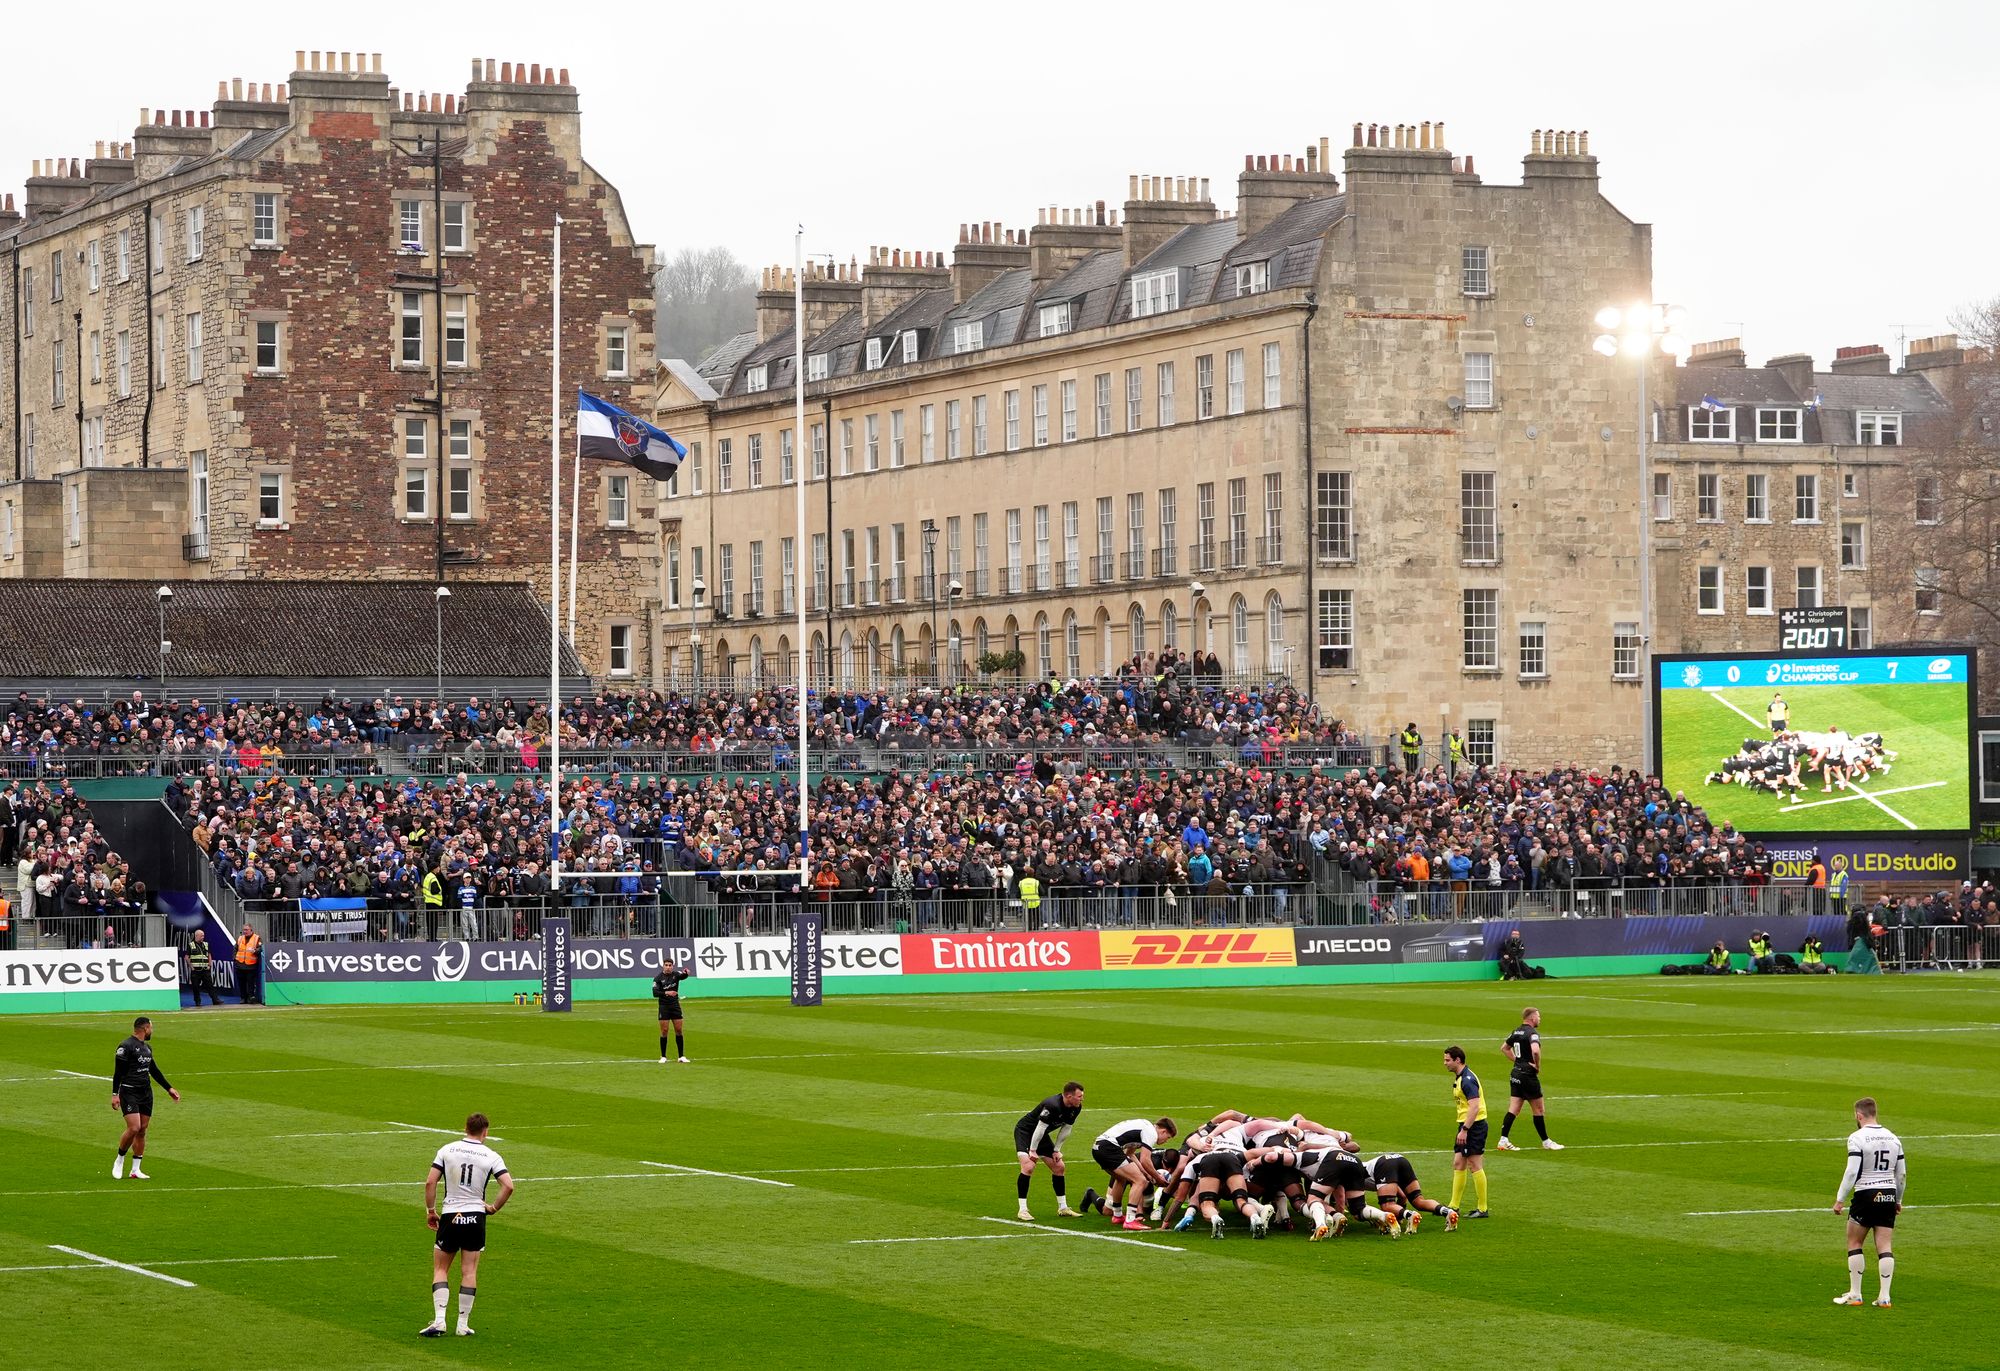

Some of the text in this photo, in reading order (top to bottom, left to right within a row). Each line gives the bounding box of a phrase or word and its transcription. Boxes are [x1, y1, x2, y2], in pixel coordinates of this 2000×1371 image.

[1782, 627, 1844, 649] 20:07
[1727, 665, 1741, 683] 0
[1781, 671, 1859, 683] CHAMPIONS CUP
[1791, 663, 1841, 673] Investec
[1886, 661, 1899, 679] 7
[330, 911, 343, 920] WE
[344, 911, 366, 920] TRUST
[734, 942, 899, 972] Invstec
[805, 922, 817, 985] Investec
[931, 935, 1071, 969] Emirates
[1130, 933, 1267, 965] DHL
[1301, 938, 1392, 954] JAECOO
[296, 949, 422, 973] Investec
[553, 926, 566, 991] Investec
[640, 947, 692, 969] CUP
[0, 958, 177, 987] nvestec
[1873, 1150, 1890, 1171] 15
[460, 1162, 474, 1187] 11
